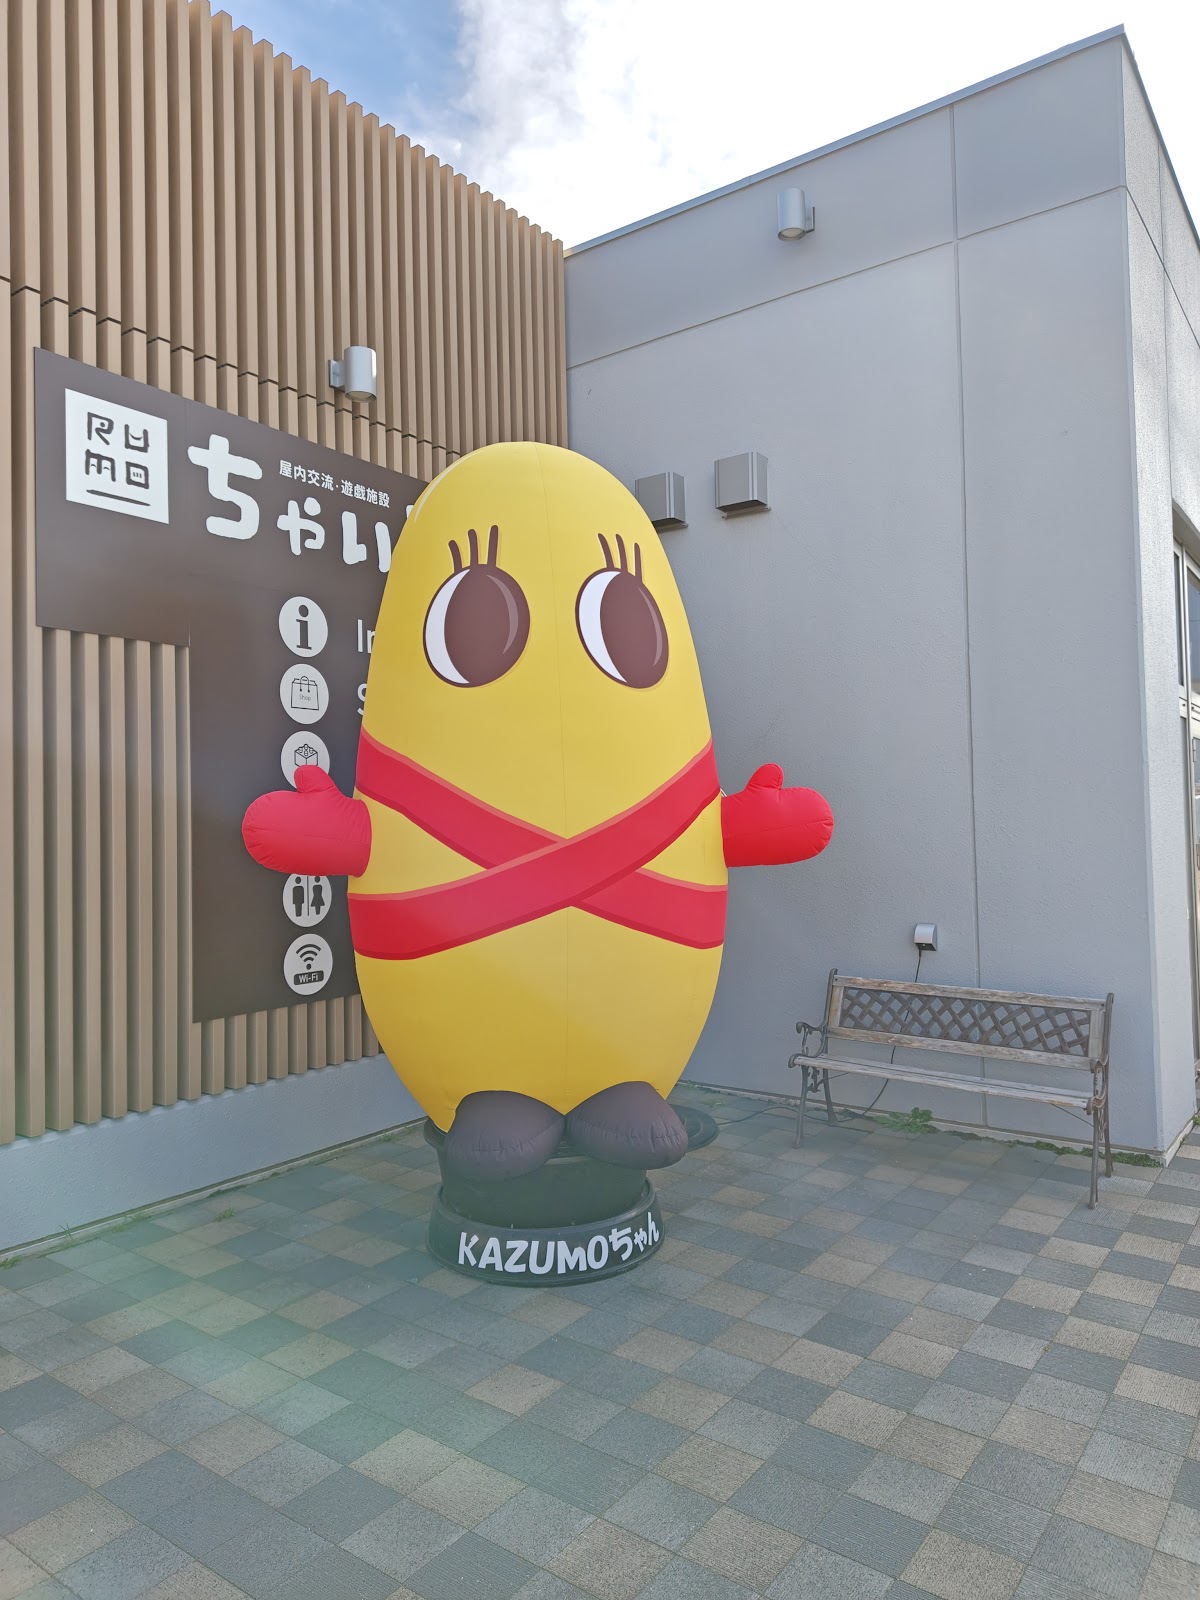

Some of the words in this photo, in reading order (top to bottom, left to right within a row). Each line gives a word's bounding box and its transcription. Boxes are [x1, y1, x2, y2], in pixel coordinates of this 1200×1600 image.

[187, 433, 414, 573] ちゃい
[279, 459, 390, 508] 屋内交流・遊戯施設
[298, 972, 319, 984] Wi-Fi
